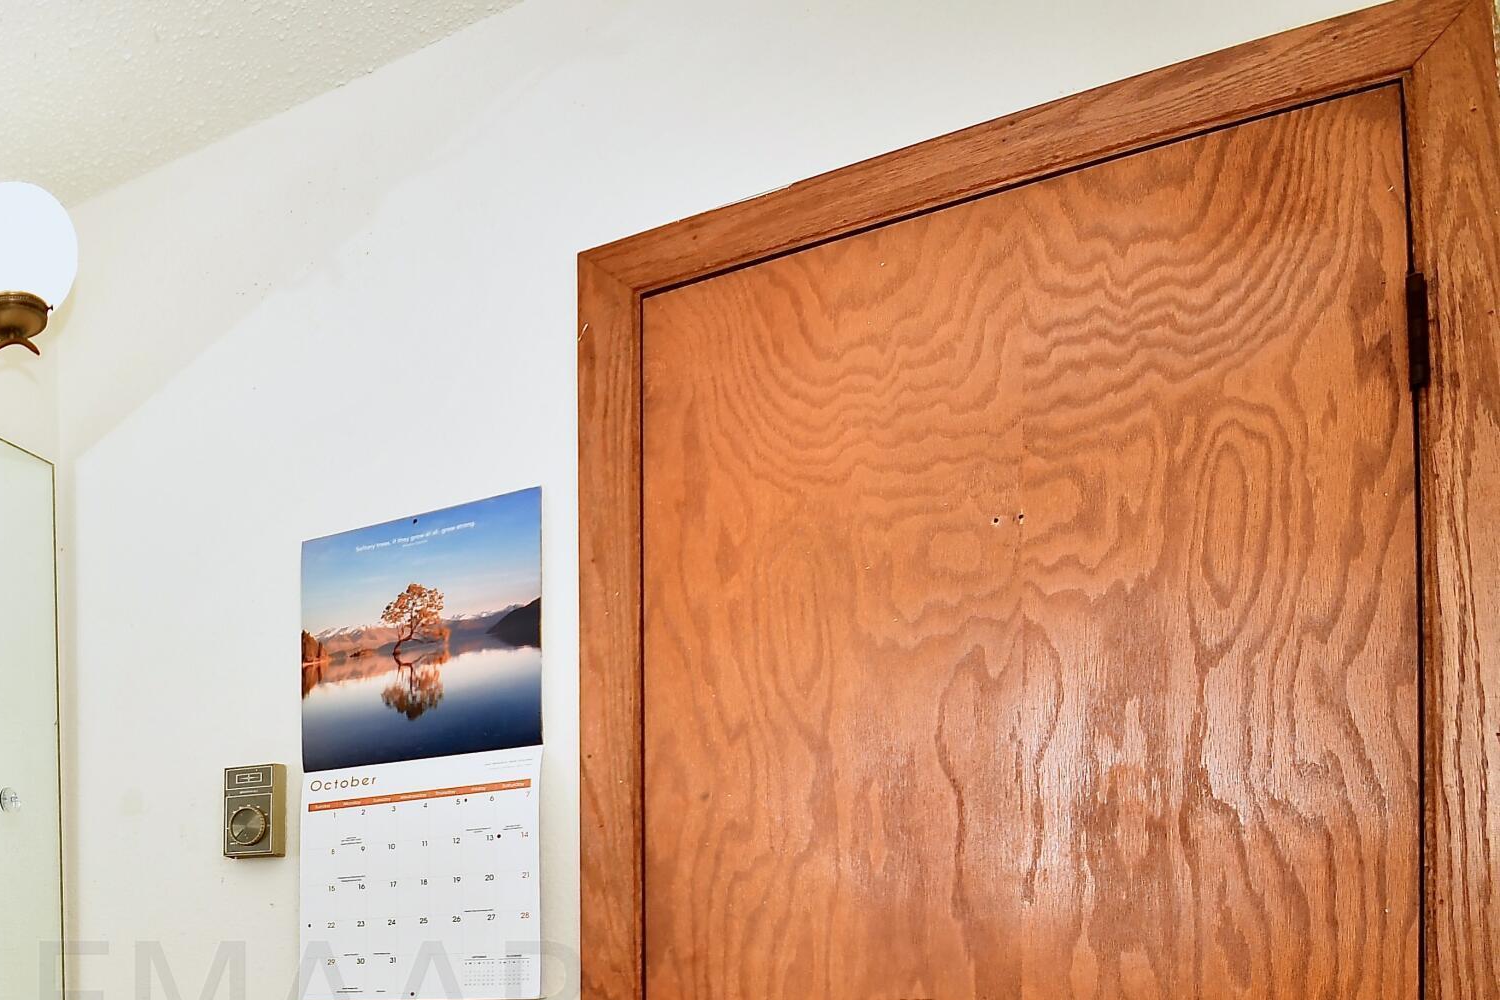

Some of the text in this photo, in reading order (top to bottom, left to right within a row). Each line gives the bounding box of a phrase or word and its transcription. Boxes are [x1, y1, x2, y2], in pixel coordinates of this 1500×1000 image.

[310, 776, 376, 792] October
[452, 837, 461, 845] 12
[486, 834, 494, 842] 13
[390, 880, 397, 888] 17
[484, 874, 495, 882] 20
[521, 871, 530, 879] 21
[327, 921, 336, 929] 22
[356, 920, 365, 928] 23
[419, 917, 429, 925] 25
[451, 915, 462, 923] 26
[487, 913, 496, 921] 27
[520, 911, 530, 919] 28
[327, 956, 397, 966] 29 30 31
